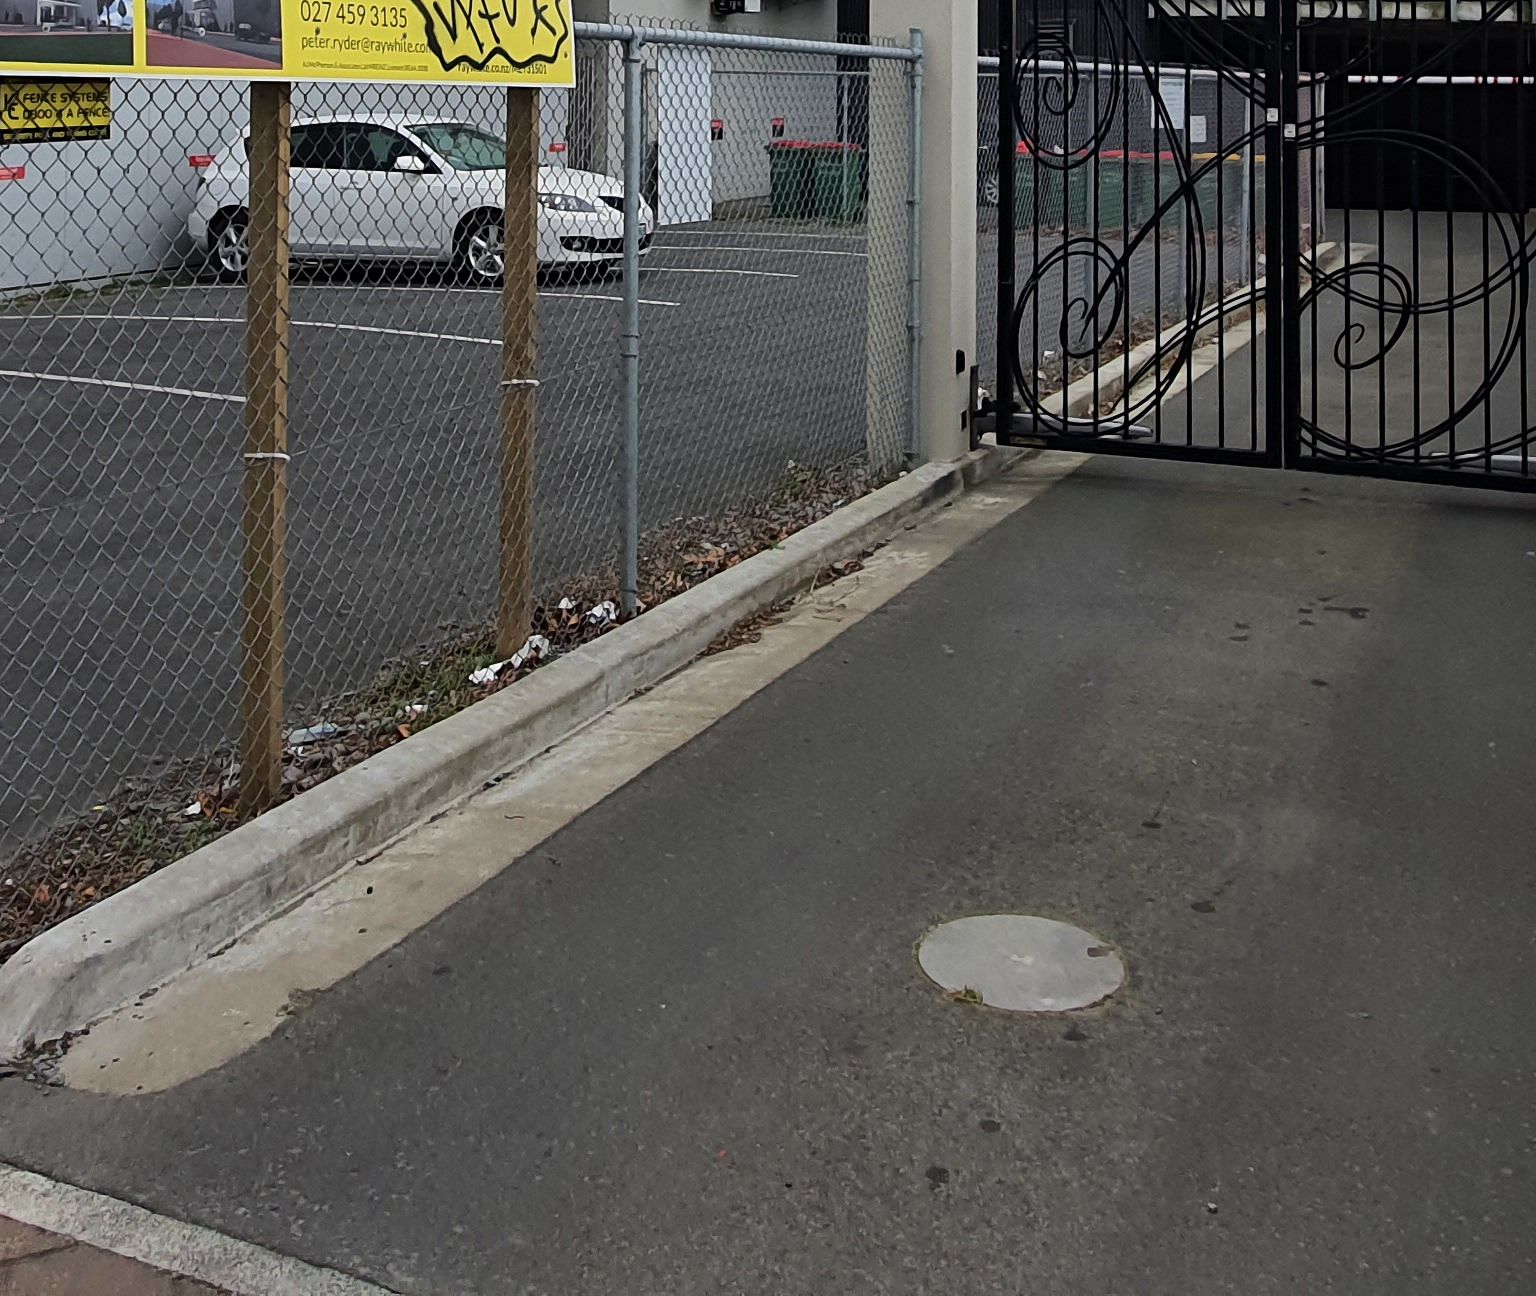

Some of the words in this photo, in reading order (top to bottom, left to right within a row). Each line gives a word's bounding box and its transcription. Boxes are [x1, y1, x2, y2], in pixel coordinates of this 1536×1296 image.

[300, 0, 332, 24] 027
[336, 2, 366, 25] 459
[370, 5, 407, 29] 3135
